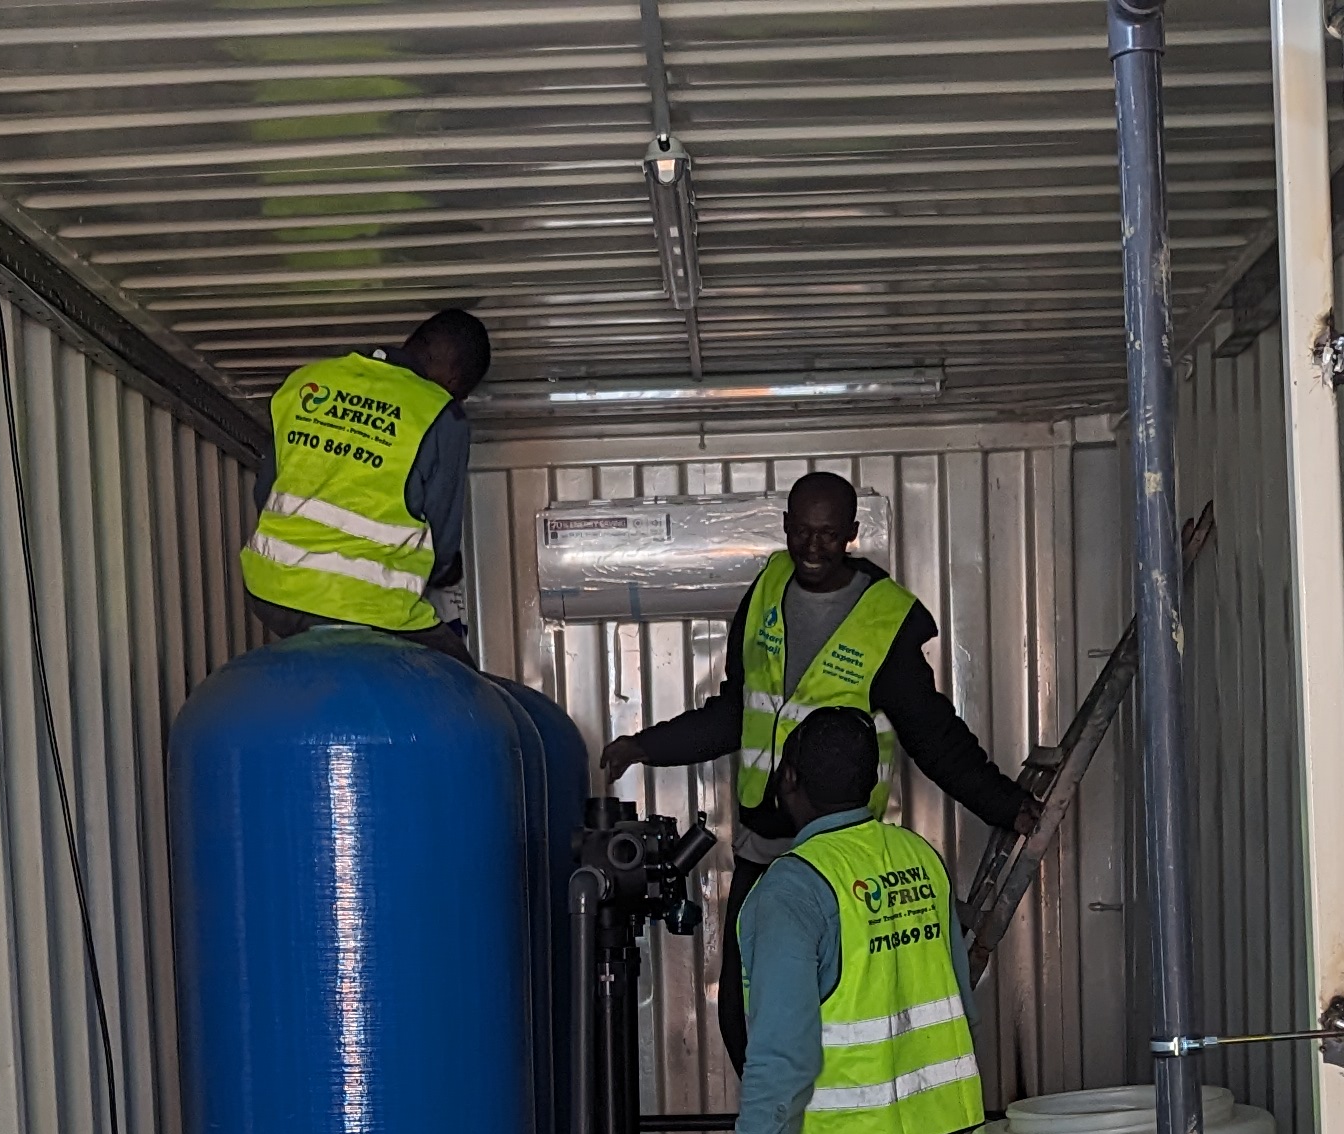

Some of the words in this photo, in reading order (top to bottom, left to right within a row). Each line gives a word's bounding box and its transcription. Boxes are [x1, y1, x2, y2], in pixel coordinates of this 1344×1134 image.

[333, 390, 401, 420] NORWA
[324, 405, 396, 437] AFRICA
[288, 431, 320, 449] 0710
[324, 439, 351, 456] 869
[353, 447, 383, 468] 870
[831, 651, 863, 667] Experts
[838, 643, 864, 658] Water
